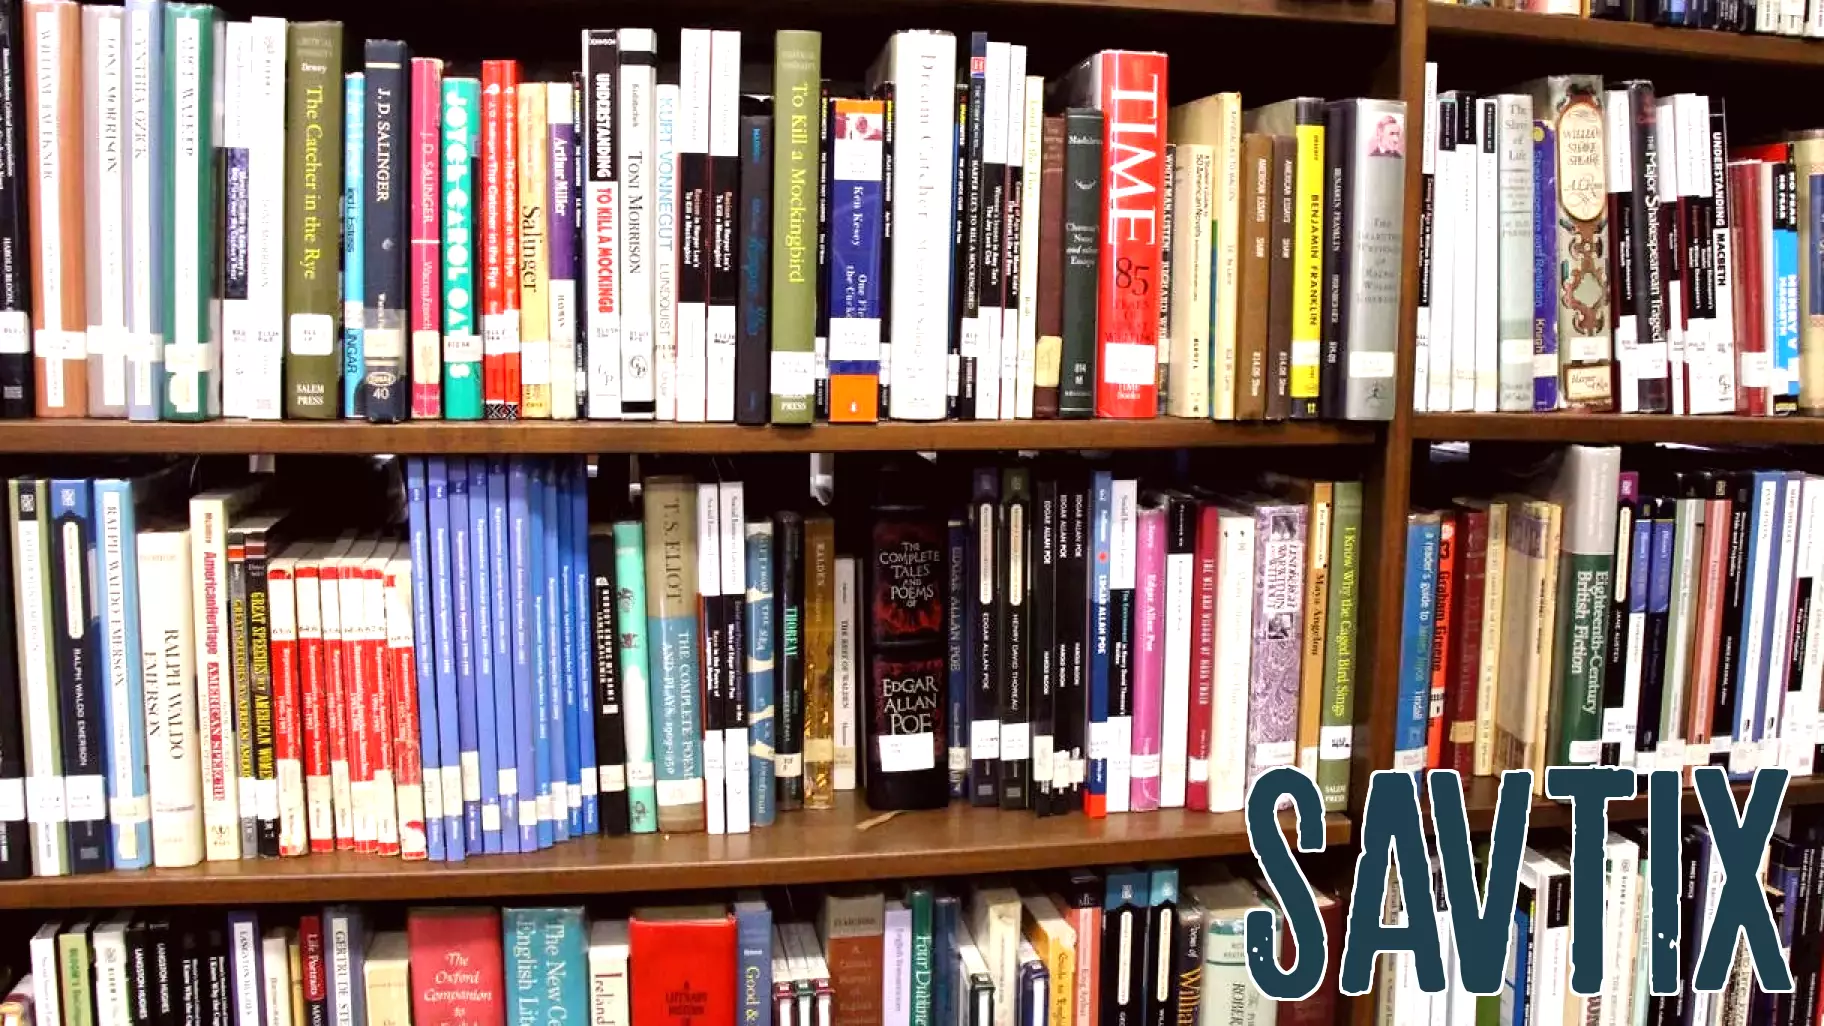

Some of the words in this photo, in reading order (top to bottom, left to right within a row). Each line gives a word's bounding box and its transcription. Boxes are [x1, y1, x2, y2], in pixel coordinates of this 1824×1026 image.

[304, 86, 323, 124] The
[376, 88, 390, 100] J.
[791, 81, 808, 106] To
[920, 55, 936, 124] Dream
[377, 103, 390, 118] D.
[595, 73, 611, 178] UNDERSTANDING
[659, 98, 671, 143] KURT
[792, 114, 809, 144] Kill
[304, 130, 323, 190] Catcher
[376, 121, 391, 202] SALINGER
[506, 160, 515, 179] The
[553, 137, 568, 178] Arthur
[628, 151, 644, 190] TONI
[792, 150, 803, 161] a
[1109, 74, 1157, 246] TIME
[1194, 155, 1203, 166] 50
[488, 162, 498, 181] The
[918, 136, 934, 217] Catcher
[970, 160, 979, 188] HARPER
[1194, 168, 1203, 206] American
[1256, 158, 1266, 195] AMERICAN
[1282, 160, 1292, 195] AMERICAN
[1332, 167, 1342, 207] BENJAMIN
[1712, 131, 1724, 227] UNDERSTANDING
[1778, 174, 1786, 188] NO
[1788, 171, 1797, 186] NO
[304, 195, 321, 210] in
[488, 183, 498, 230] Catcher
[506, 180, 515, 224] Catcher
[554, 179, 568, 216] Miller
[597, 187, 611, 202] TO
[659, 151, 672, 251] VONNEGUT
[853, 186, 863, 209] Ken
[969, 190, 978, 214] LEE'S
[1255, 198, 1265, 222] ESSAYS
[1282, 198, 1291, 222] ESSAYS
[1777, 191, 1786, 220] FEAR
[1788, 190, 1797, 225] FEAR
[304, 216, 323, 242] the
[506, 226, 514, 235] in
[597, 205, 611, 233] KILL
[628, 194, 643, 275] MORRISON
[786, 168, 806, 283] Mockingbird
[850, 213, 863, 247] Kesey
[969, 216, 977, 225] TO
[1193, 207, 1203, 238] Novels
[1309, 195, 1320, 259] BENJAMIN
[1332, 211, 1341, 252] FRANKLIN
[488, 233, 498, 243] in
[506, 237, 515, 256] the
[521, 205, 543, 293] Salinger
[598, 235, 612, 245] A
[969, 227, 977, 244] KILL
[1255, 237, 1265, 258] SHAW
[1281, 238, 1291, 258] SHAW
[301, 248, 322, 280] Rye
[488, 246, 498, 264] the
[504, 258, 516, 277] Rye
[1715, 233, 1727, 287] MACBETH
[486, 267, 498, 288] Rye
[598, 247, 613, 313] MOCKINGB
[857, 274, 867, 295] One
[967, 254, 977, 309] MOCKINGBIRD
[1116, 257, 1150, 296] 85
[659, 263, 670, 336] LUNDQUIST
[1309, 266, 1319, 327] FRANKLIN
[1778, 277, 1788, 337] MACBETH
[1787, 274, 1798, 335] HENRY
[1787, 338, 1797, 350] V
[296, 383, 325, 393] SALEM
[296, 396, 325, 406] PRESS
[371, 388, 389, 400] 40
[782, 401, 808, 411] PRESS
[663, 499, 679, 515] T.
[107, 506, 120, 554] RALPH
[664, 521, 680, 536] S.
[879, 551, 940, 565] COMPLETE
[1343, 535, 1355, 568] Know
[1422, 543, 1433, 579] reader's
[665, 541, 683, 603] ELIOT
[890, 564, 931, 579] TALES
[950, 546, 962, 592] EDGAR
[1340, 569, 1355, 596] Why
[108, 561, 123, 615] WALDO
[891, 586, 933, 601] POEMS
[1098, 574, 1107, 605] EDGAR
[1145, 574, 1155, 603] Edgar
[1314, 574, 1325, 607] Maya
[1419, 582, 1430, 608] guide
[1433, 571, 1450, 621] Graham
[1574, 570, 1593, 619] British
[949, 596, 960, 640] ALLAN
[1097, 607, 1107, 635] ALLAN
[1146, 605, 1155, 632] Allan
[1340, 599, 1352, 618] the
[1420, 611, 1429, 621] to
[1614, 609, 1622, 630] JANE
[1011, 614, 1019, 643] HENRY
[1146, 634, 1154, 652] Poe
[1310, 610, 1323, 655] Angelou
[1336, 620, 1351, 655] Caged
[1582, 570, 1610, 715] Eighteenth-Century
[110, 619, 125, 687] EMERSON
[164, 629, 181, 687] RALPH
[950, 645, 960, 671] POE
[1011, 645, 1019, 669] DAVID
[1097, 636, 1106, 655] POE
[1432, 626, 1445, 672] Greene
[1570, 625, 1587, 674] Fiction
[1612, 633, 1620, 663] AUSTEN
[73, 648, 83, 681] RALPH
[1336, 658, 1349, 683] Bird
[75, 683, 85, 718] WALDO
[143, 651, 161, 738] EMERSON
[882, 676, 939, 697] EDGAR
[1010, 671, 1019, 710] THOREAU
[1333, 684, 1348, 718] Sings
[884, 694, 937, 714] ALLAN
[165, 692, 185, 760] WALDO
[890, 713, 933, 735] POE
[76, 720, 88, 766] EMERSON
[545, 921, 565, 955] The
[135, 948, 145, 987] LANGSTON
[157, 943, 168, 982] LANGSTON
[445, 952, 469, 967] The
[513, 921, 536, 991] English
[434, 971, 480, 984] Oxford
[546, 962, 566, 1001] New
[746, 966, 760, 1005] Good
[138, 990, 148, 1019] HUGHES
[160, 984, 170, 1013] HUGHES
[423, 989, 492, 1002] Companion
